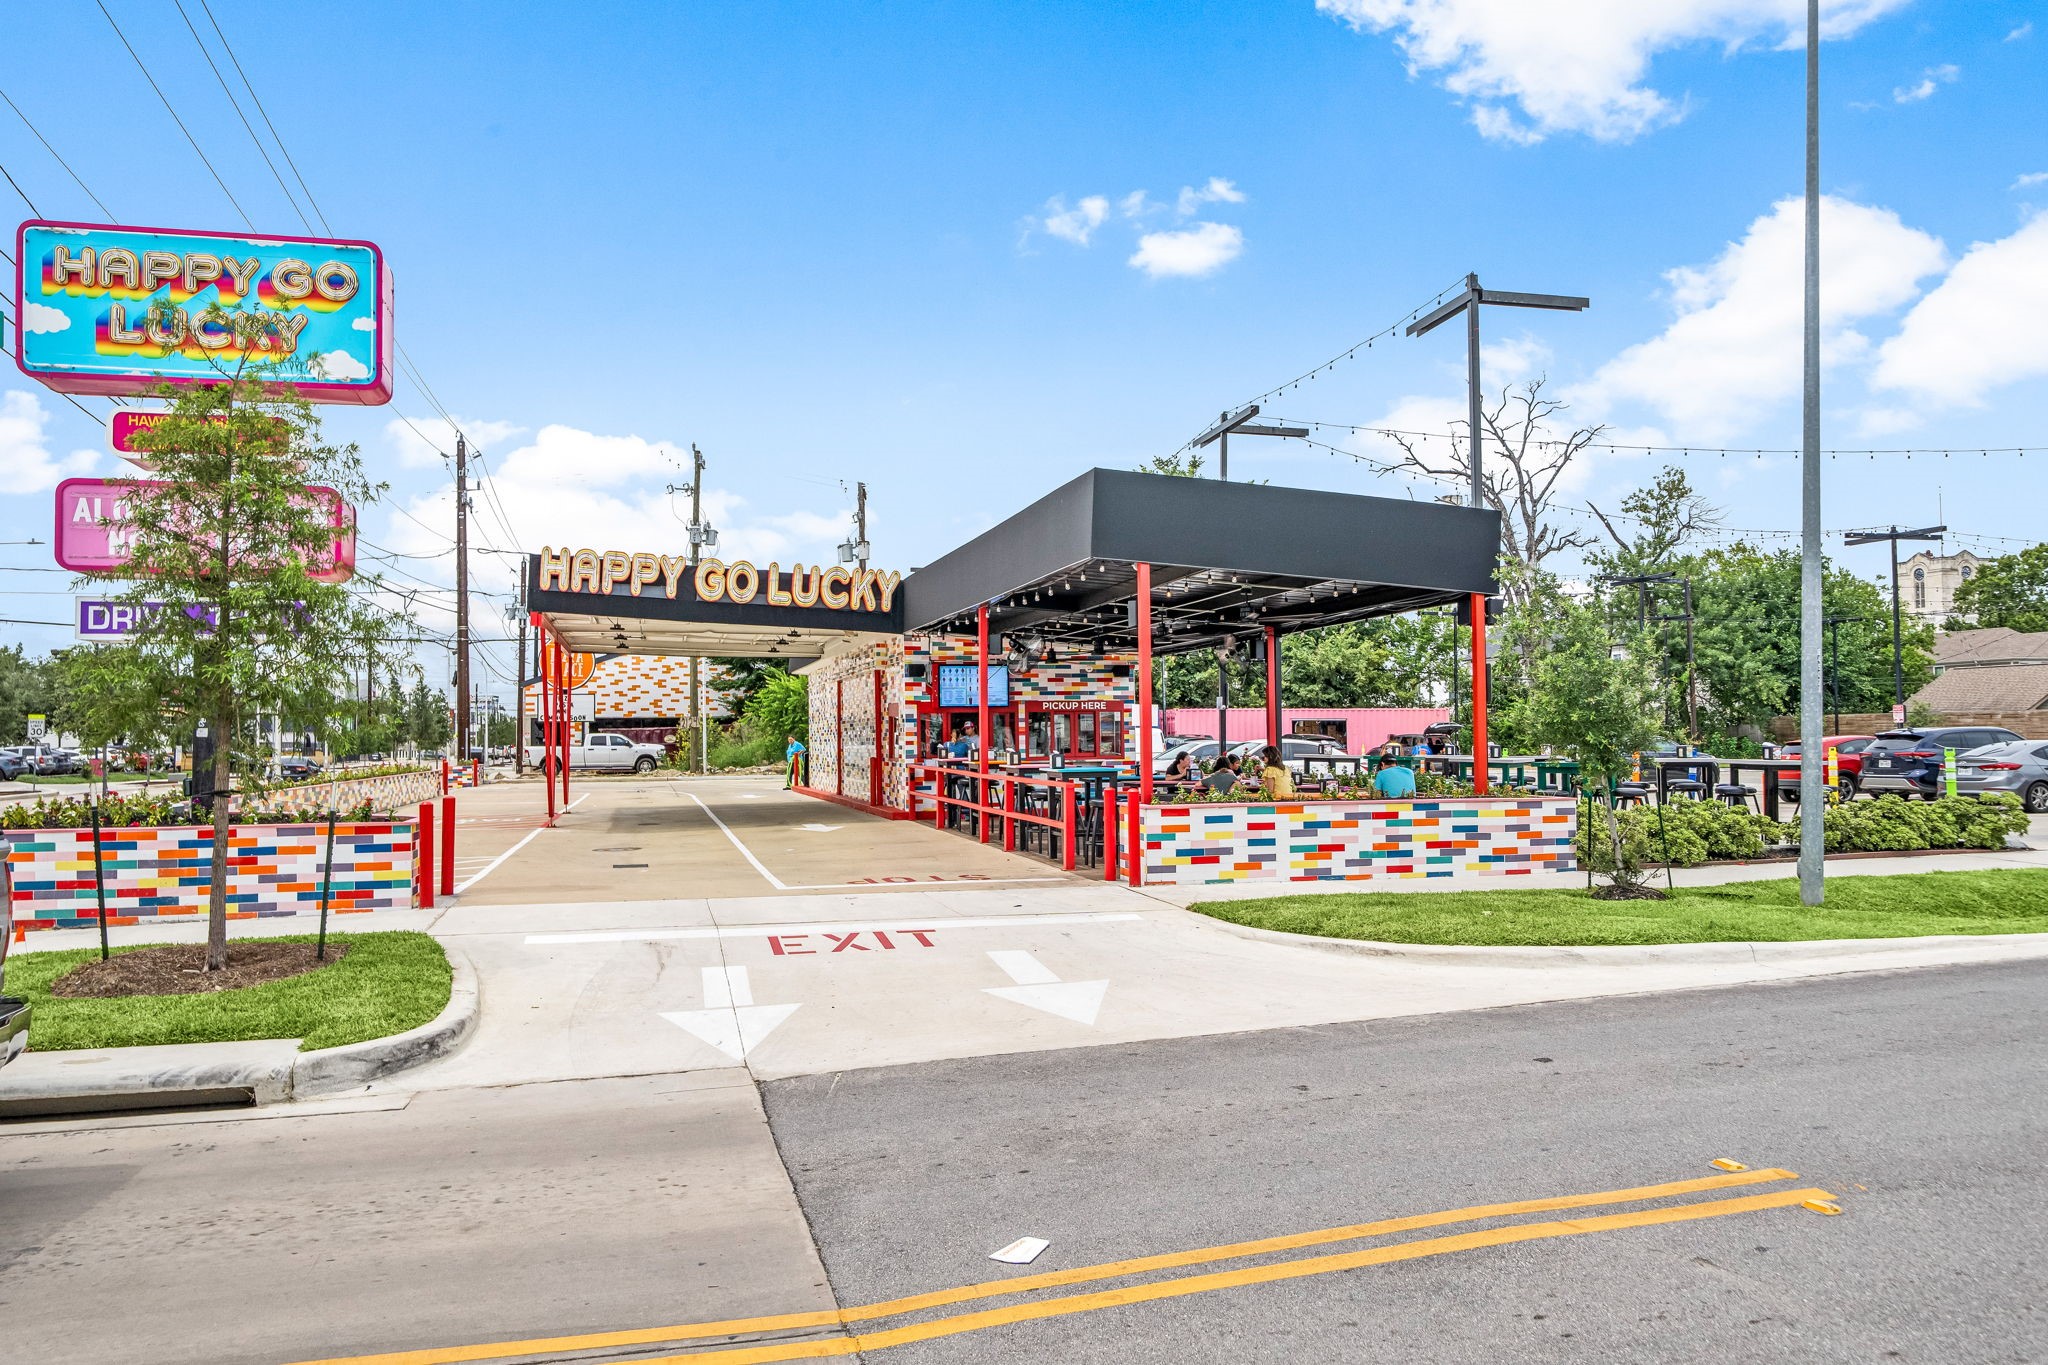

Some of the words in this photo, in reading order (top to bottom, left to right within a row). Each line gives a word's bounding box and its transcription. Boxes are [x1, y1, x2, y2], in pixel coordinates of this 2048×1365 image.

[51, 244, 261, 298] HAPPY
[269, 257, 360, 302] GO
[107, 302, 308, 352] LUCKY
[538, 545, 687, 600] HAPPY
[694, 557, 760, 605] GO
[766, 561, 902, 613] LUCKY
[1042, 701, 1079, 710] PICKUP
[1081, 701, 1106, 710] HERE
[767, 928, 937, 956] EXIT
